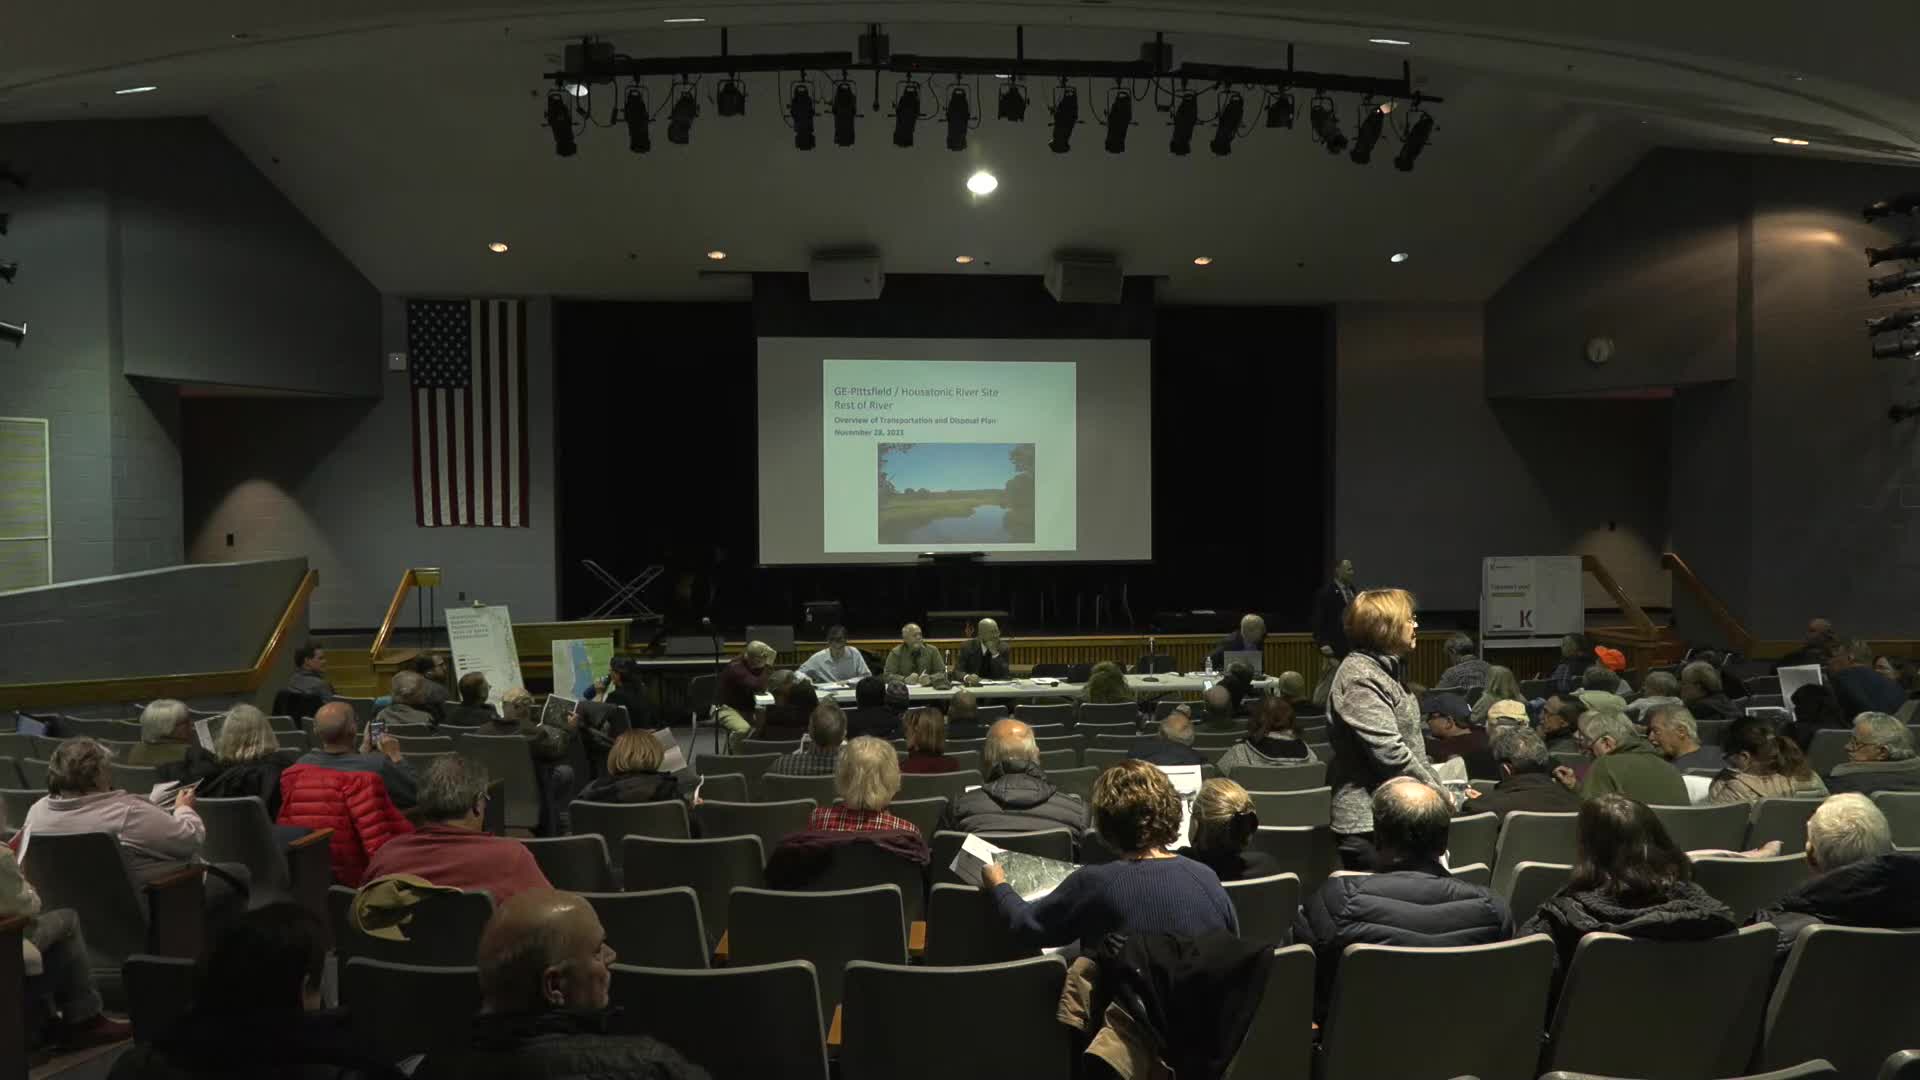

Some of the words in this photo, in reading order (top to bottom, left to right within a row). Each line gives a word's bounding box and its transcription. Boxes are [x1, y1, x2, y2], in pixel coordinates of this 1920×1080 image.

[833, 386, 892, 397] GE-Pittsfield
[901, 386, 953, 397] Housatonic
[955, 387, 978, 397] River
[980, 387, 999, 397] Site
[834, 400, 856, 410] Rest
[857, 400, 867, 410] of
[869, 400, 894, 410] River
[833, 416, 868, 424] Overview
[870, 416, 878, 424] of
[879, 416, 933, 425] Transportation
[949, 416, 979, 425] Disposal
[980, 417, 996, 425] Plan
[834, 428, 873, 437] November
